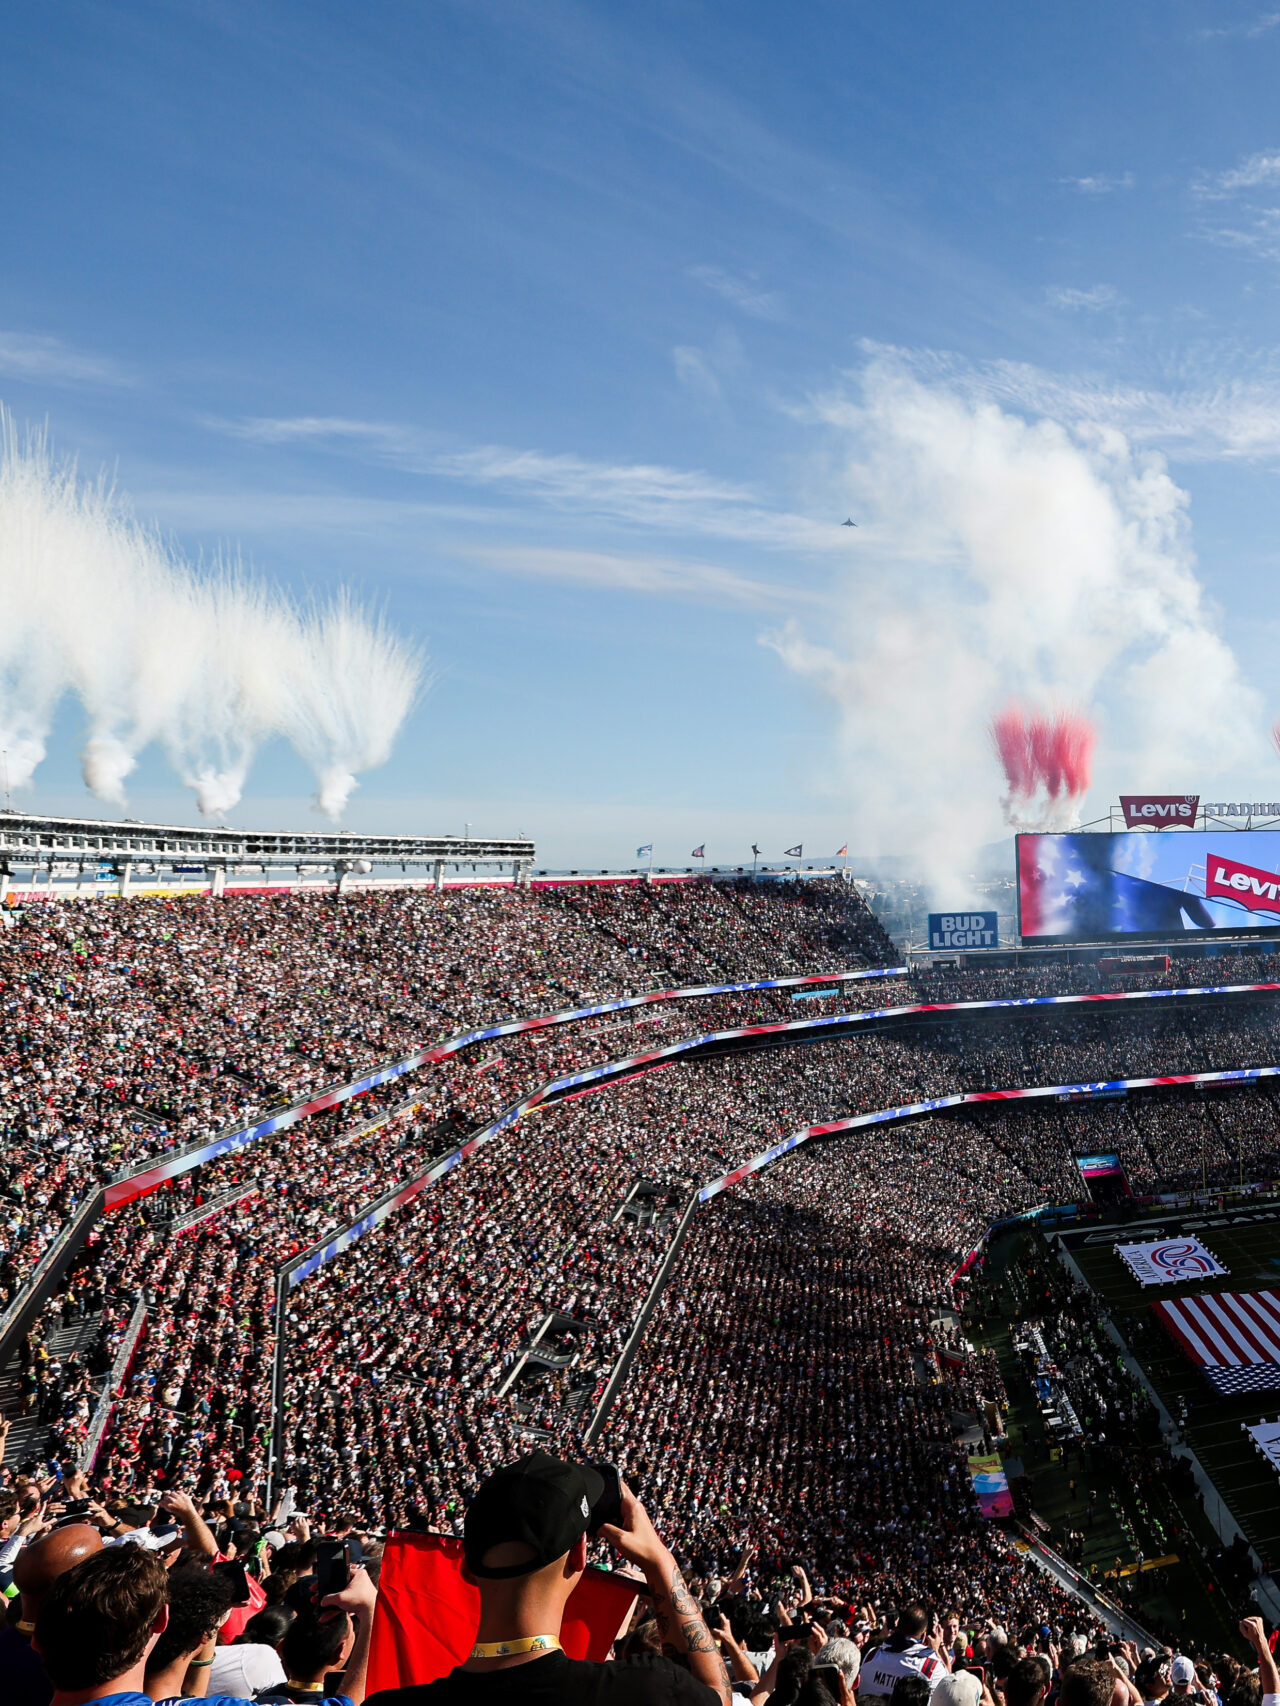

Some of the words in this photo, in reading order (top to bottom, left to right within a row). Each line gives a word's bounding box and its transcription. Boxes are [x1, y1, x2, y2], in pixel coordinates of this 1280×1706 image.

[941, 915, 985, 931] BUD
[932, 931, 994, 947] LIGHT
[1125, 1250, 1160, 1279] AMERICA
